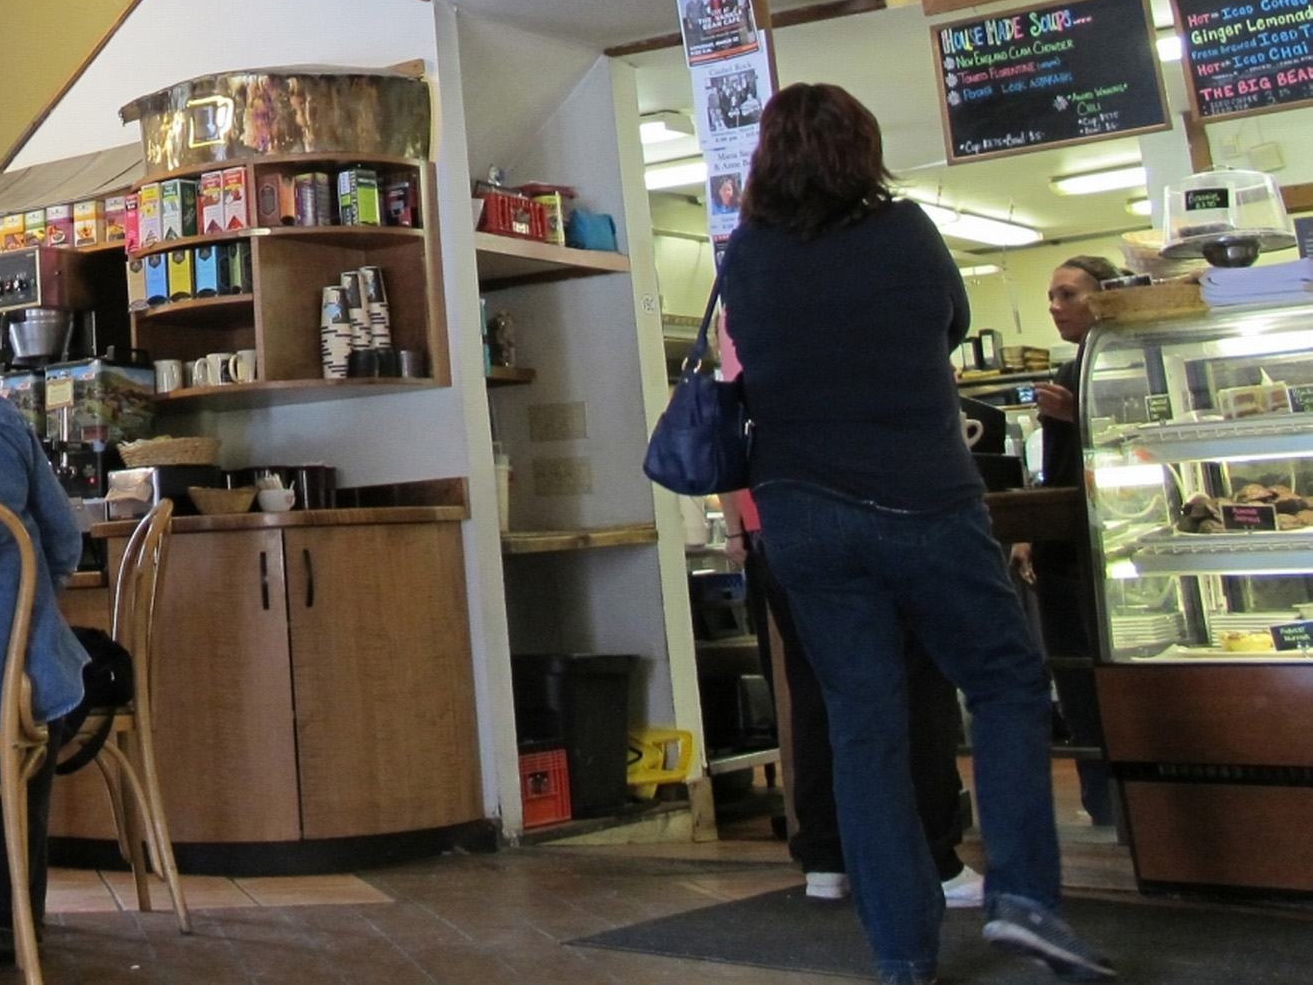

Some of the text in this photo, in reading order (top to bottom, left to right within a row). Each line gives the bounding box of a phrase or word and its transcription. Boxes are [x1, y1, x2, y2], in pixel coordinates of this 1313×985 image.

[1187, 13, 1209, 27] Hot
[1221, 5, 1253, 19] Iced
[1191, 23, 1242, 44] Ginger
[1246, 5, 1313, 31] Lemonad
[941, 27, 983, 53] HOUSE
[985, 17, 1023, 45] MADE
[1258, 30, 1298, 47] Iced
[973, 51, 1008, 65] ENGLAND
[1008, 46, 1032, 59] CLAM
[1032, 39, 1073, 54] CHOWDER
[1197, 63, 1219, 75] Hot
[1232, 53, 1265, 68] Iced
[1269, 41, 1308, 60] Chai
[989, 62, 1035, 78] FLORENTINE
[1199, 85, 1234, 101] THE
[1238, 77, 1271, 93] BIG
